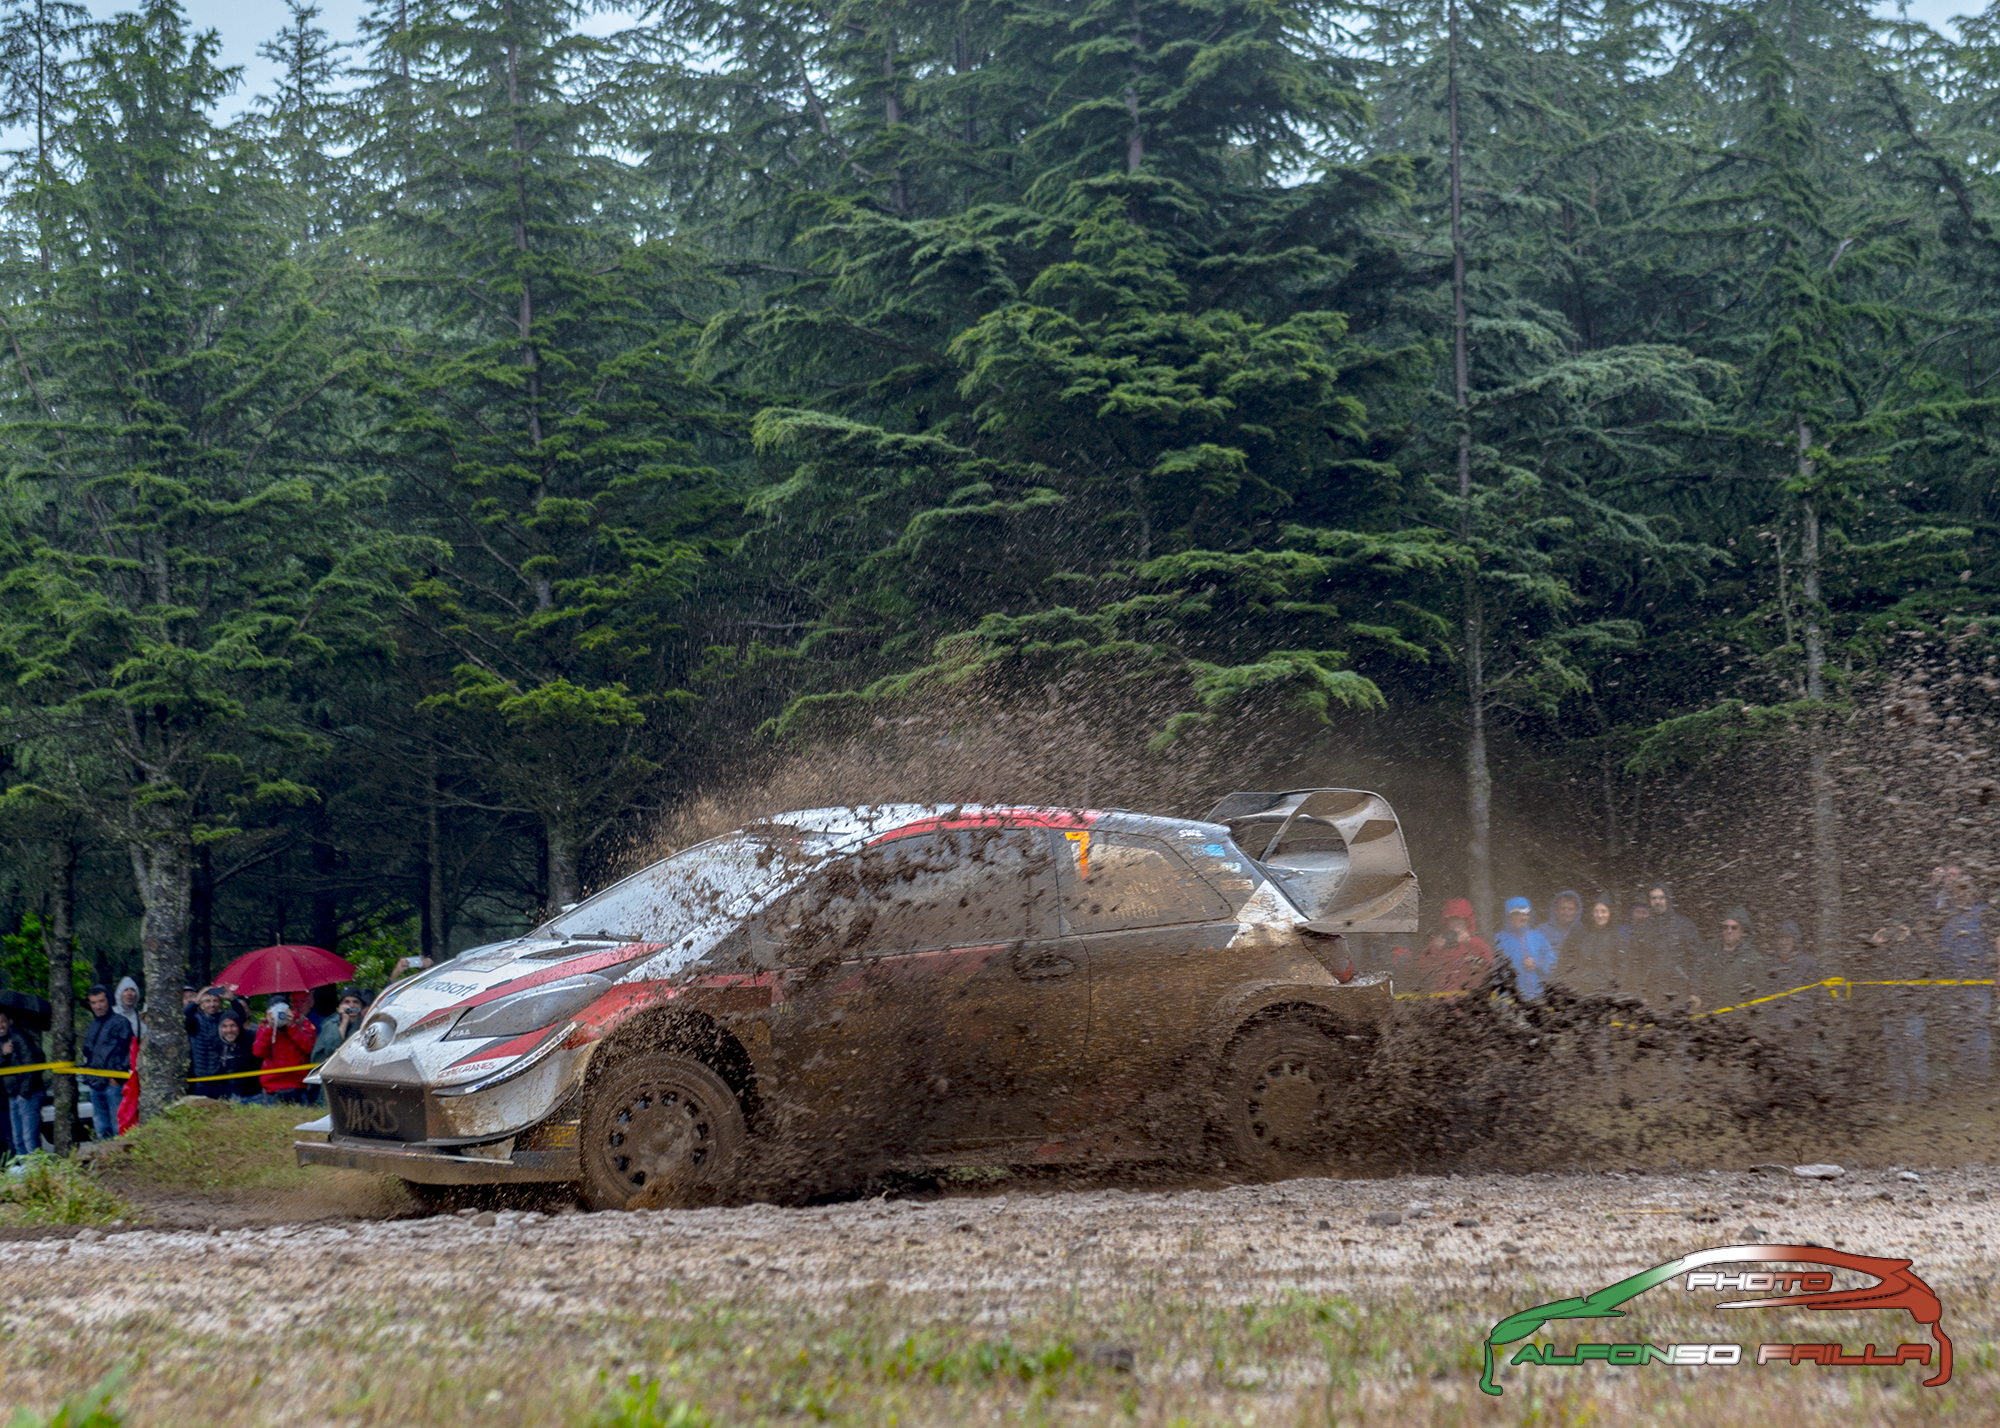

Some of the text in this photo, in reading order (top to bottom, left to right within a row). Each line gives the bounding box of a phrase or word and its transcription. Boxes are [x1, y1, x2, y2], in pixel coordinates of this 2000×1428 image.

[1064, 831, 1090, 880] 7
[425, 1014, 451, 1030] MORI
[450, 1028, 472, 1039] PIAA
